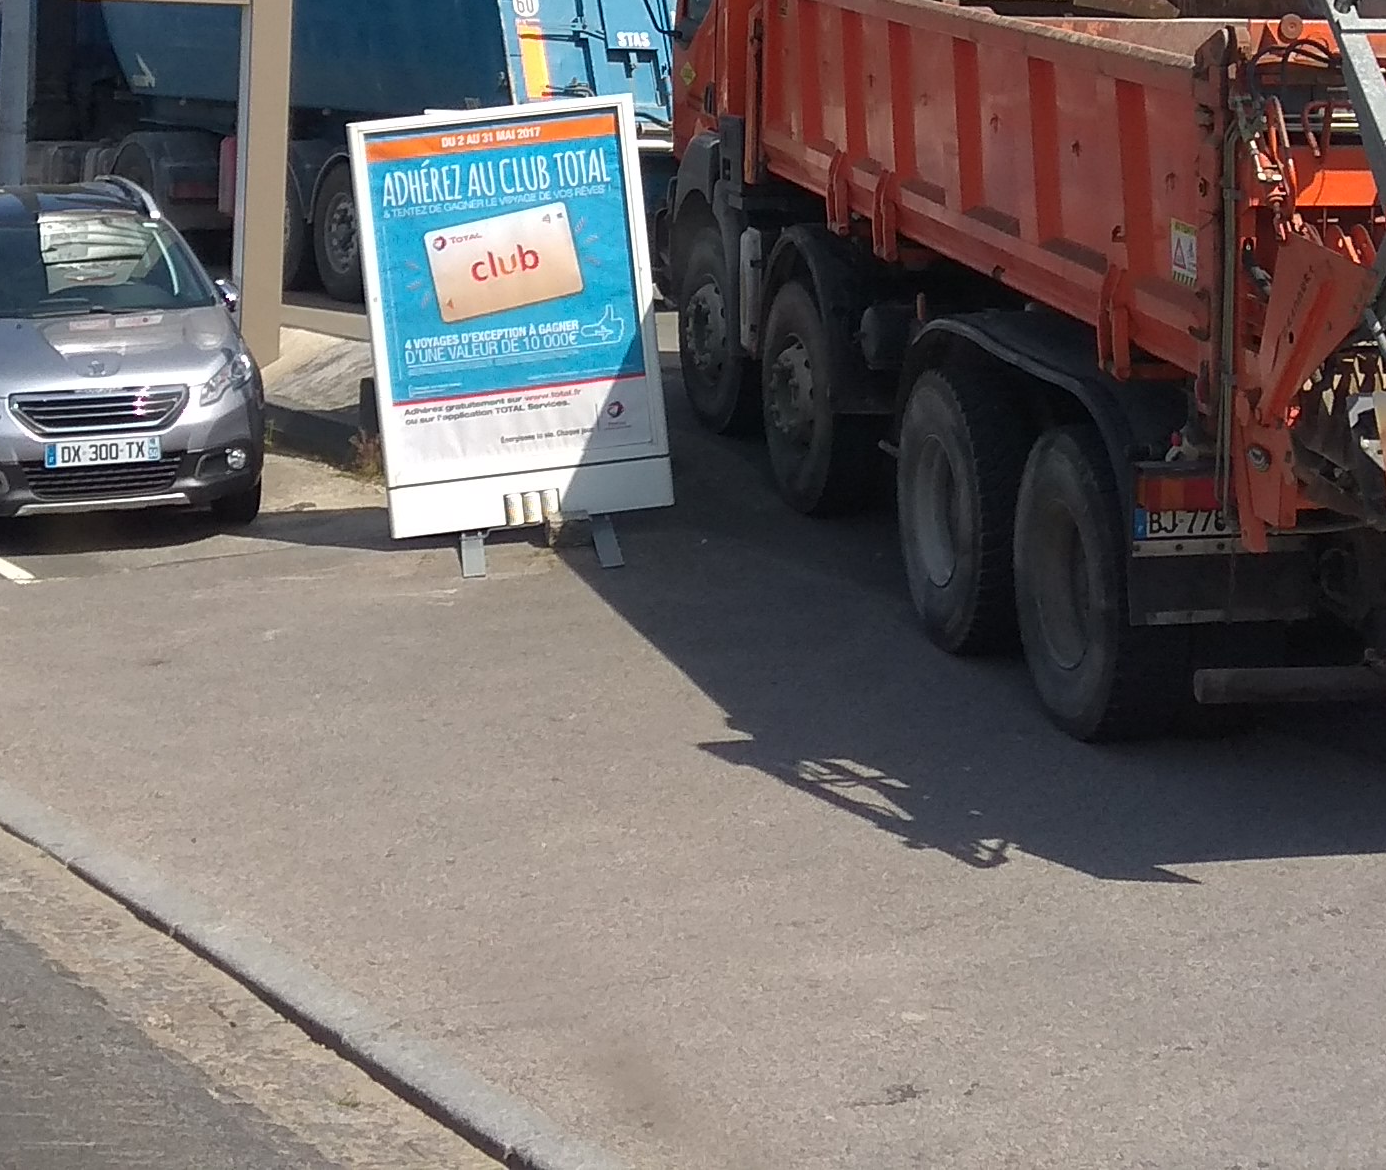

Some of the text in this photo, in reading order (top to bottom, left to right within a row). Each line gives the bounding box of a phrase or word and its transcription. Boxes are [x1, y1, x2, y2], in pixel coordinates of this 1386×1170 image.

[616, 31, 650, 48] STAS
[441, 126, 541, 148] DU 2 AU 31 MAI 2017
[382, 147, 611, 207] ADHÉREZ AU CLUB TOTAL
[391, 205, 428, 217] TENTEZ
[429, 203, 442, 214] DE
[443, 198, 484, 210] GAGNER
[485, 197, 498, 207] LE
[538, 190, 552, 200] DE
[449, 232, 482, 245] TOTAL
[471, 244, 540, 282] club
[404, 319, 579, 349] 4 VOYAGES D'EXCEPTION À GAGNER
[404, 330, 580, 365] D'UNE VALEUR DE 10 000€
[507, 396, 522, 404] sur
[419, 416, 435, 424] sur
[494, 405, 525, 414] TOTAL
